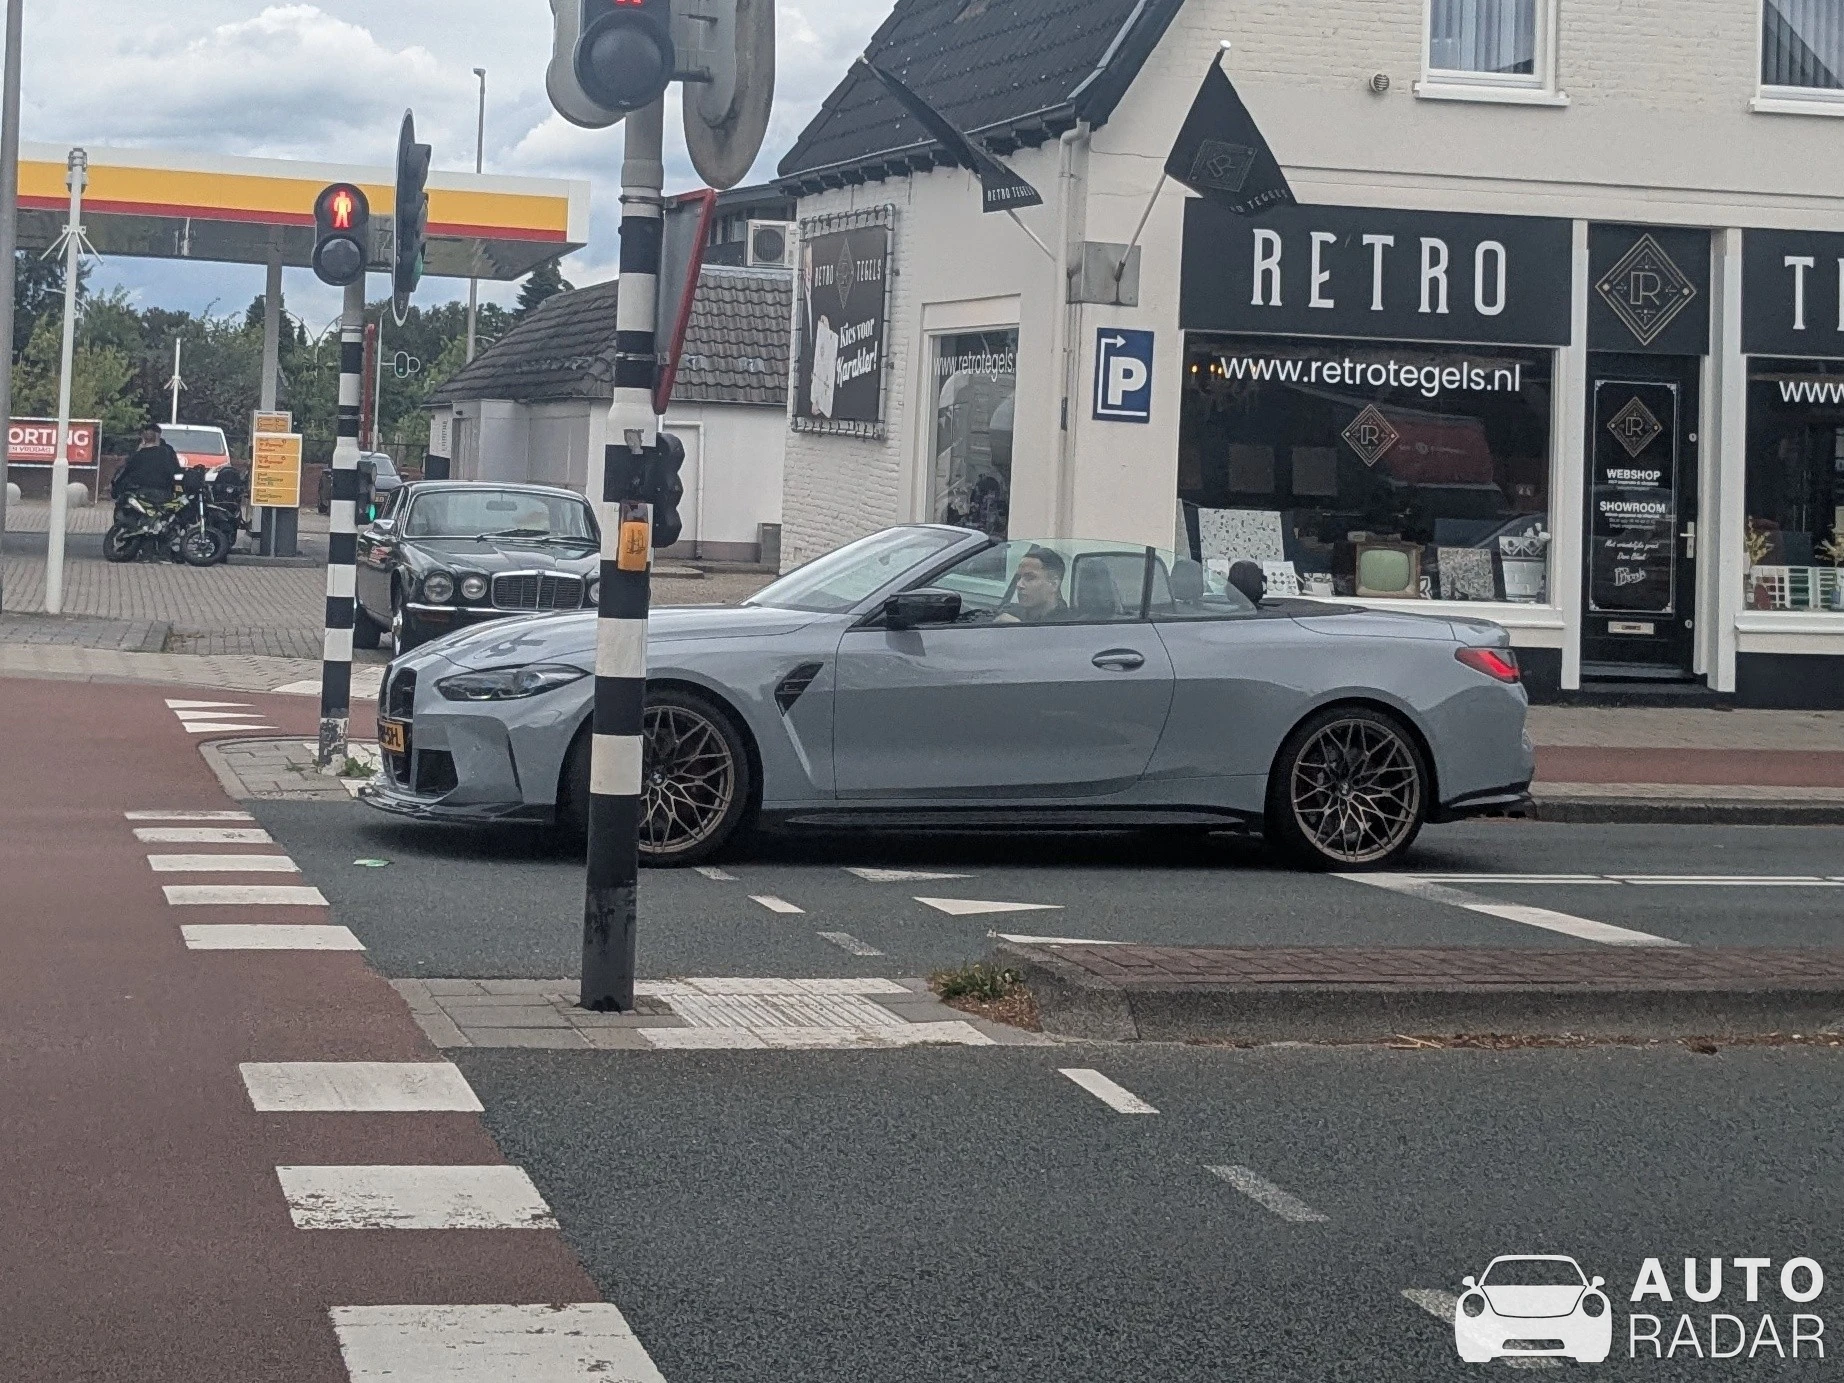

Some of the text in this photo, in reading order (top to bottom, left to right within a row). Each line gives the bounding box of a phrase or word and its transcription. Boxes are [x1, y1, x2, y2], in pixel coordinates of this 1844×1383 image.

[815, 258, 881, 288] RETRO TEGELS
[1250, 228, 1506, 316] RETRO
[856, 317, 875, 343] voor
[1107, 355, 1148, 406] P
[1220, 356, 1521, 398] www.retrotegels.nl
[1606, 468, 1661, 481] WEBSHOP
[1599, 500, 1666, 514] SHOWROOM
